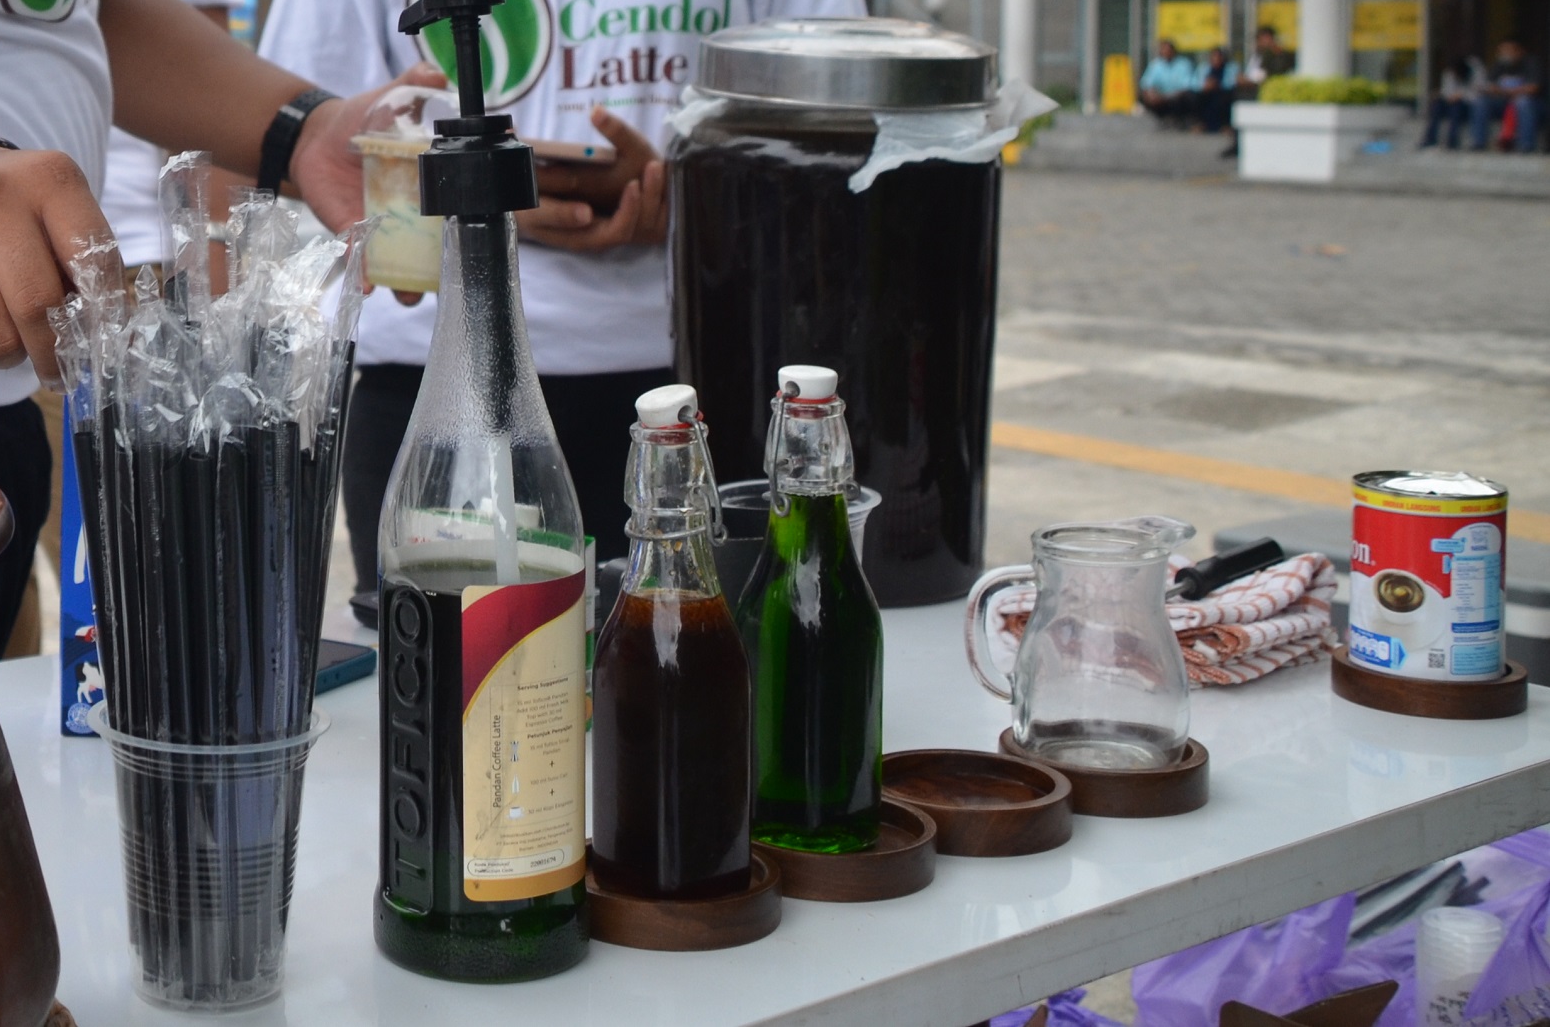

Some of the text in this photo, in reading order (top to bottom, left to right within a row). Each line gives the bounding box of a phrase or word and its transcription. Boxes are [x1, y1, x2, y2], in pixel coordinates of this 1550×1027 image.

[559, 45, 689, 92] Latte
[539, 677, 569, 687] Suggestions
[390, 587, 428, 888] TOFICO
[491, 714, 502, 809] Pandan Coffee Latte
